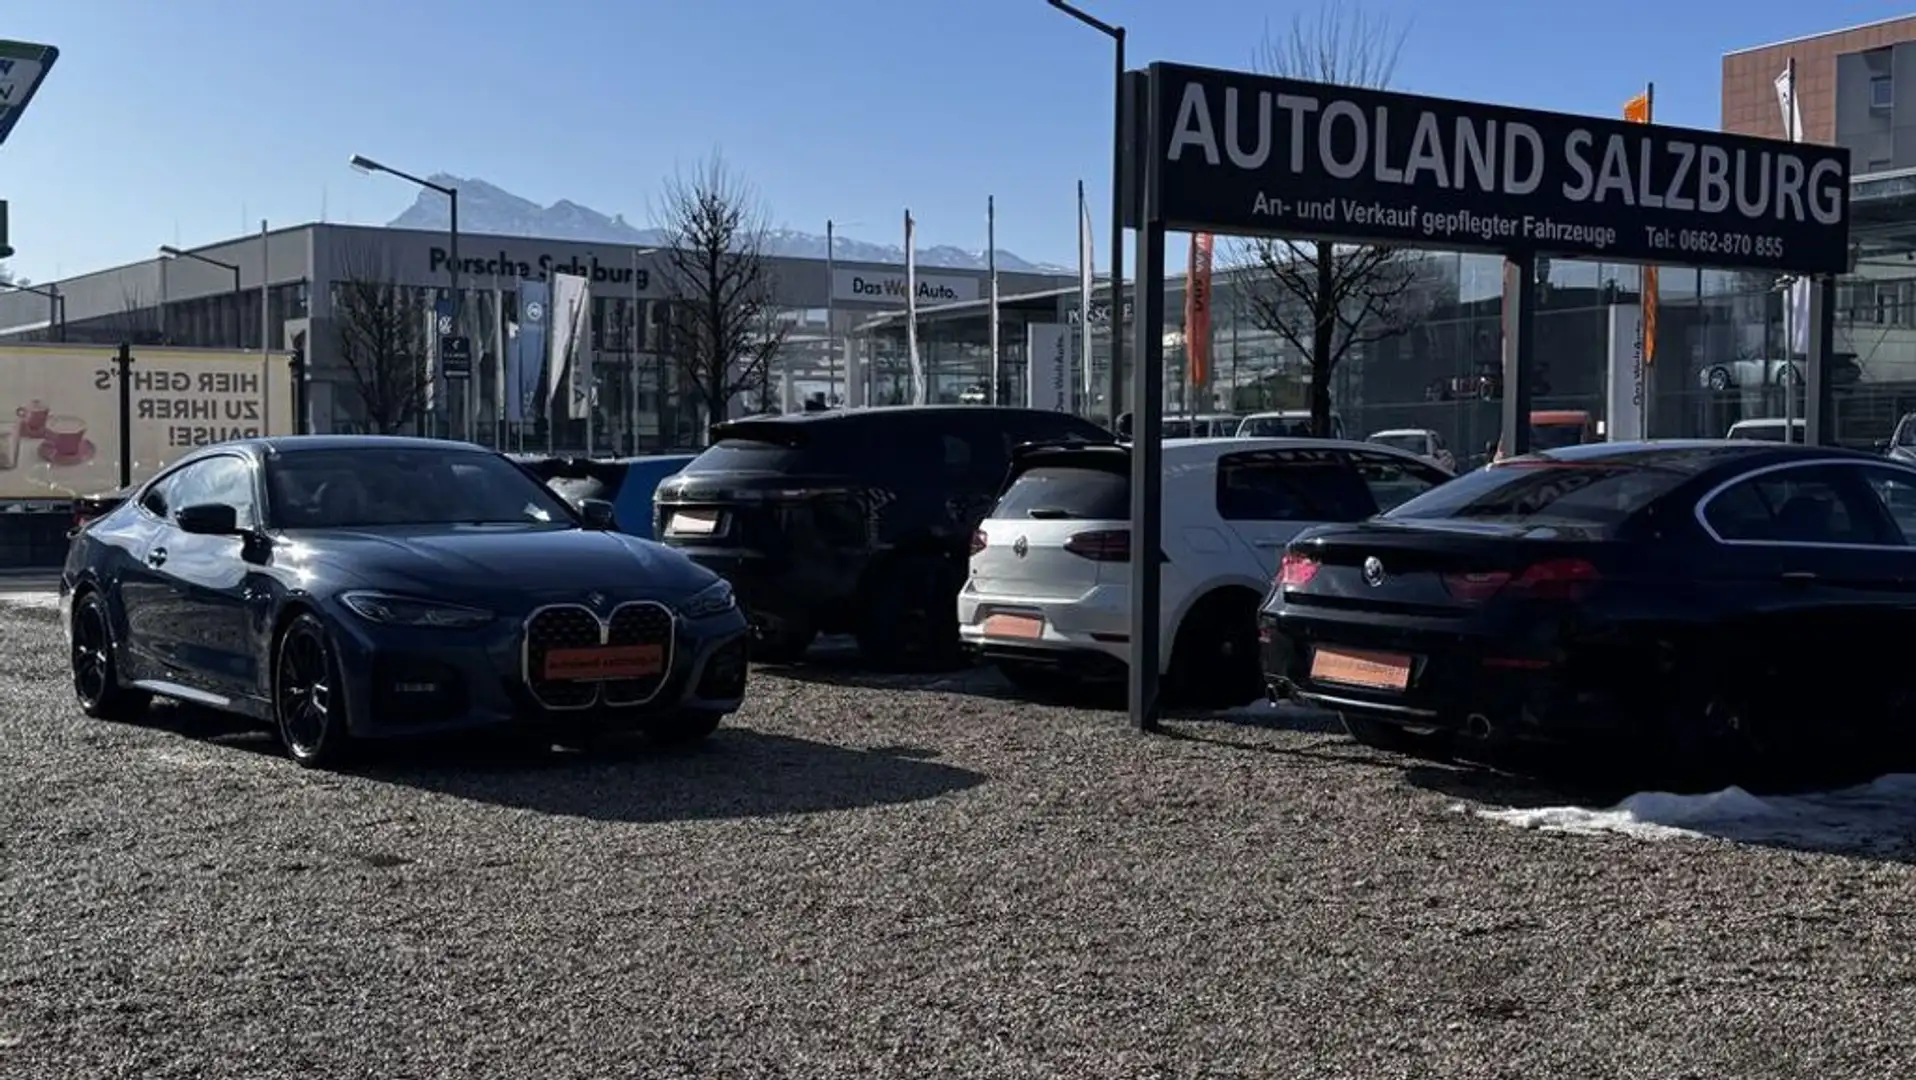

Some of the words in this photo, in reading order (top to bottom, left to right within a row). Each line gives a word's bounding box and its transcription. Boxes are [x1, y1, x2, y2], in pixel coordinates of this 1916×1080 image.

[1167, 82, 1545, 195] AUTOLAND
[1562, 129, 1843, 225] SALZBURG
[1252, 191, 1292, 216] An-
[1297, 198, 1336, 220] und
[1341, 199, 1418, 228] Verkauf
[1422, 209, 1519, 240] gepflegter
[1523, 215, 1616, 249] Fahrzeuge
[1645, 225, 1675, 248] Tel:
[1679, 229, 1751, 255] 0662-870
[1755, 235, 1784, 258] 855
[430, 246, 530, 277] Porsche
